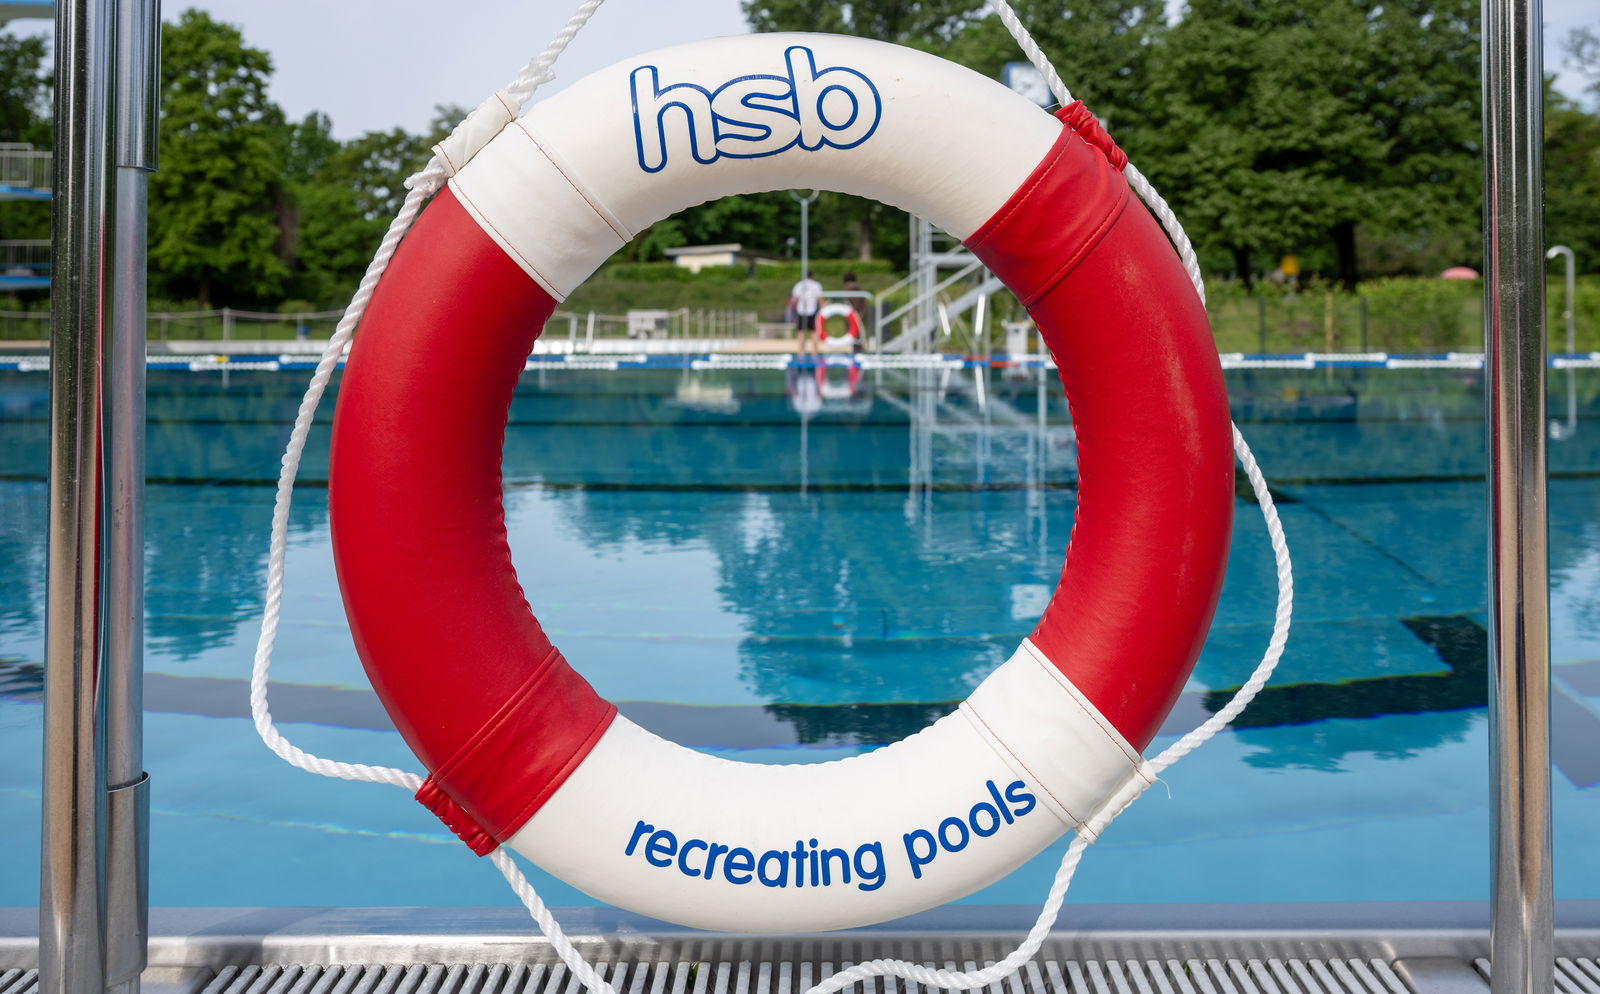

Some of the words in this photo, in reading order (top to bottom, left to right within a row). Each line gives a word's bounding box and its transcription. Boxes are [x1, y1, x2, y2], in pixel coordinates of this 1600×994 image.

[630, 45, 881, 173] hsb
[625, 820, 887, 891] recreating
[903, 779, 1037, 879] pools
